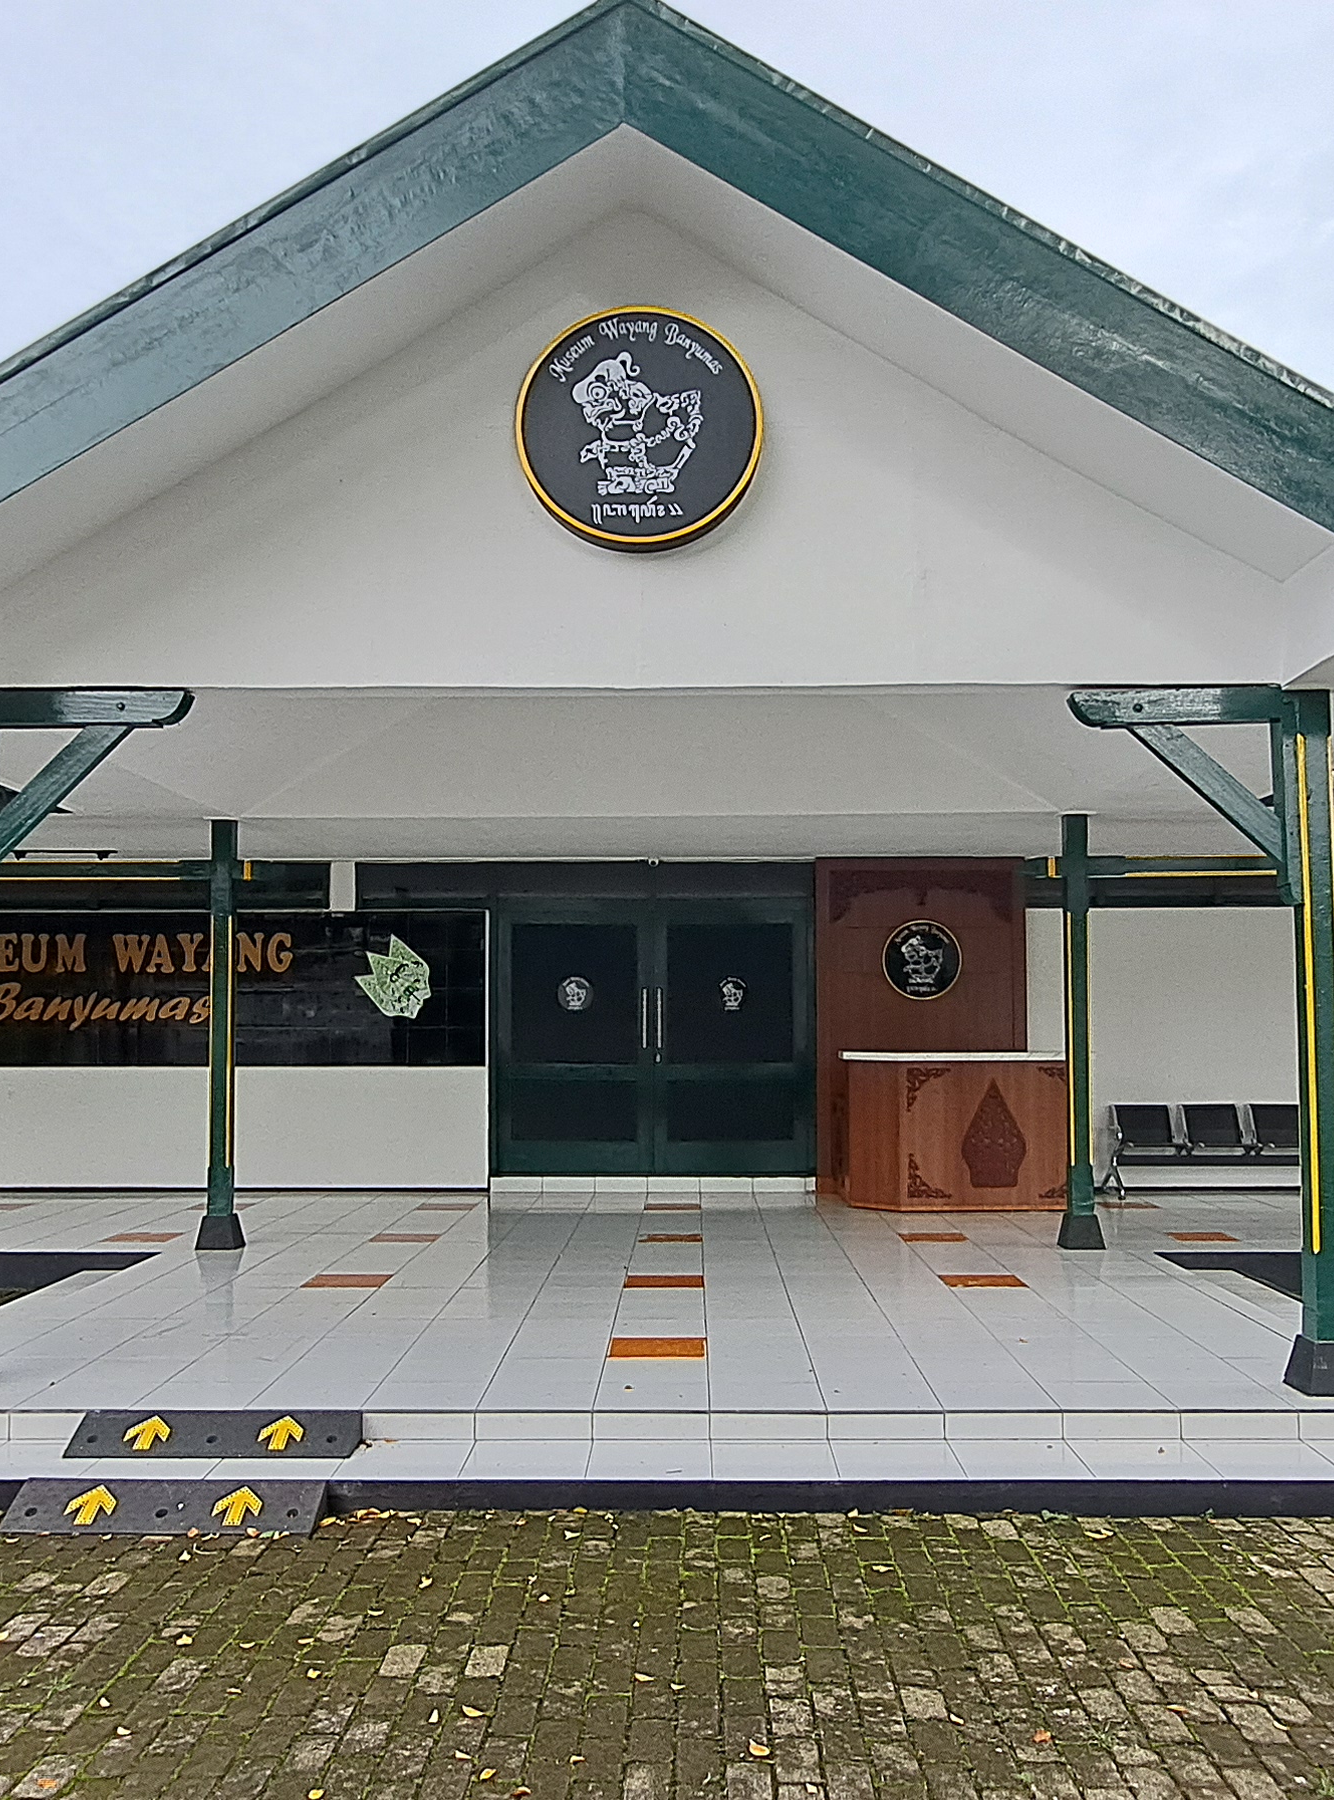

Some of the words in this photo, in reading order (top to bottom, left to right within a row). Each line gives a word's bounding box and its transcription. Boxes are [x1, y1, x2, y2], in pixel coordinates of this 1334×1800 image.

[548, 334, 596, 382] Museum
[598, 317, 658, 342] Wayang
[663, 323, 723, 375] Banyumas
[113, 932, 293, 973] WAYNG
